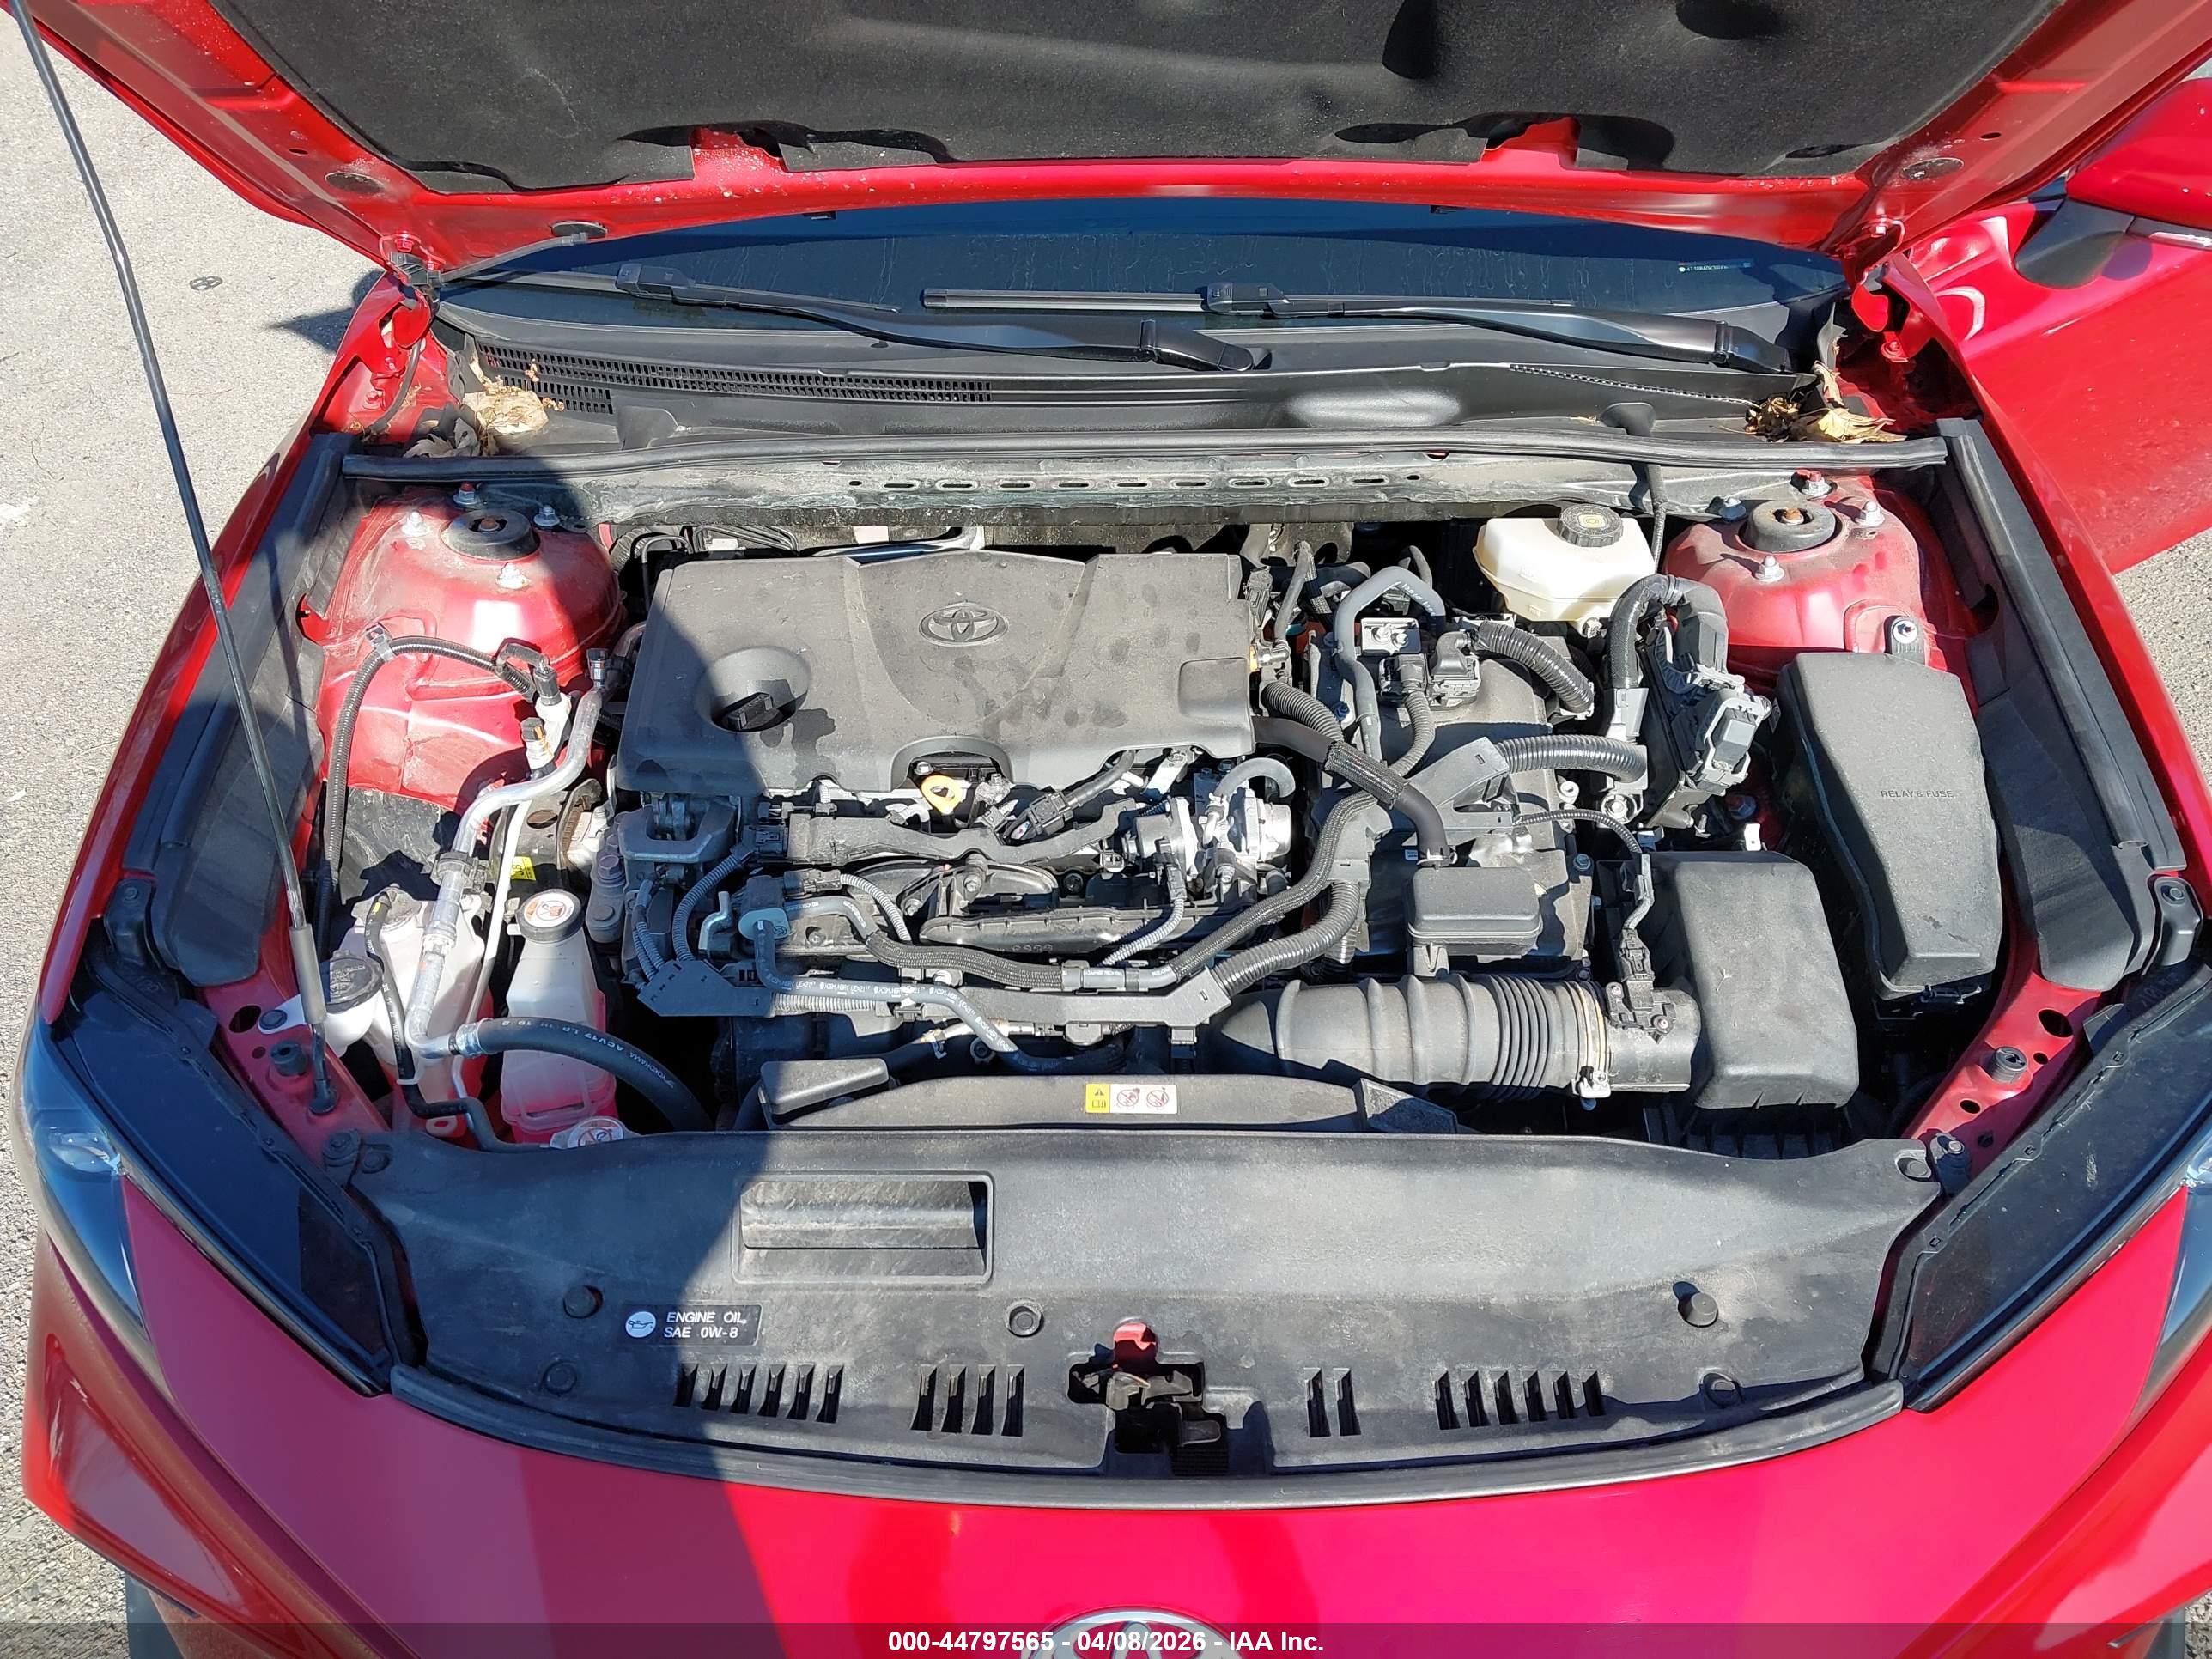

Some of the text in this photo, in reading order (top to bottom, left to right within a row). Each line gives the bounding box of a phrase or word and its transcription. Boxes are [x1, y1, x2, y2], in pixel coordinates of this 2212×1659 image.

[666, 1311, 744, 1323] ENGINE OIL
[664, 1326, 738, 1338] SAE 0W-8
